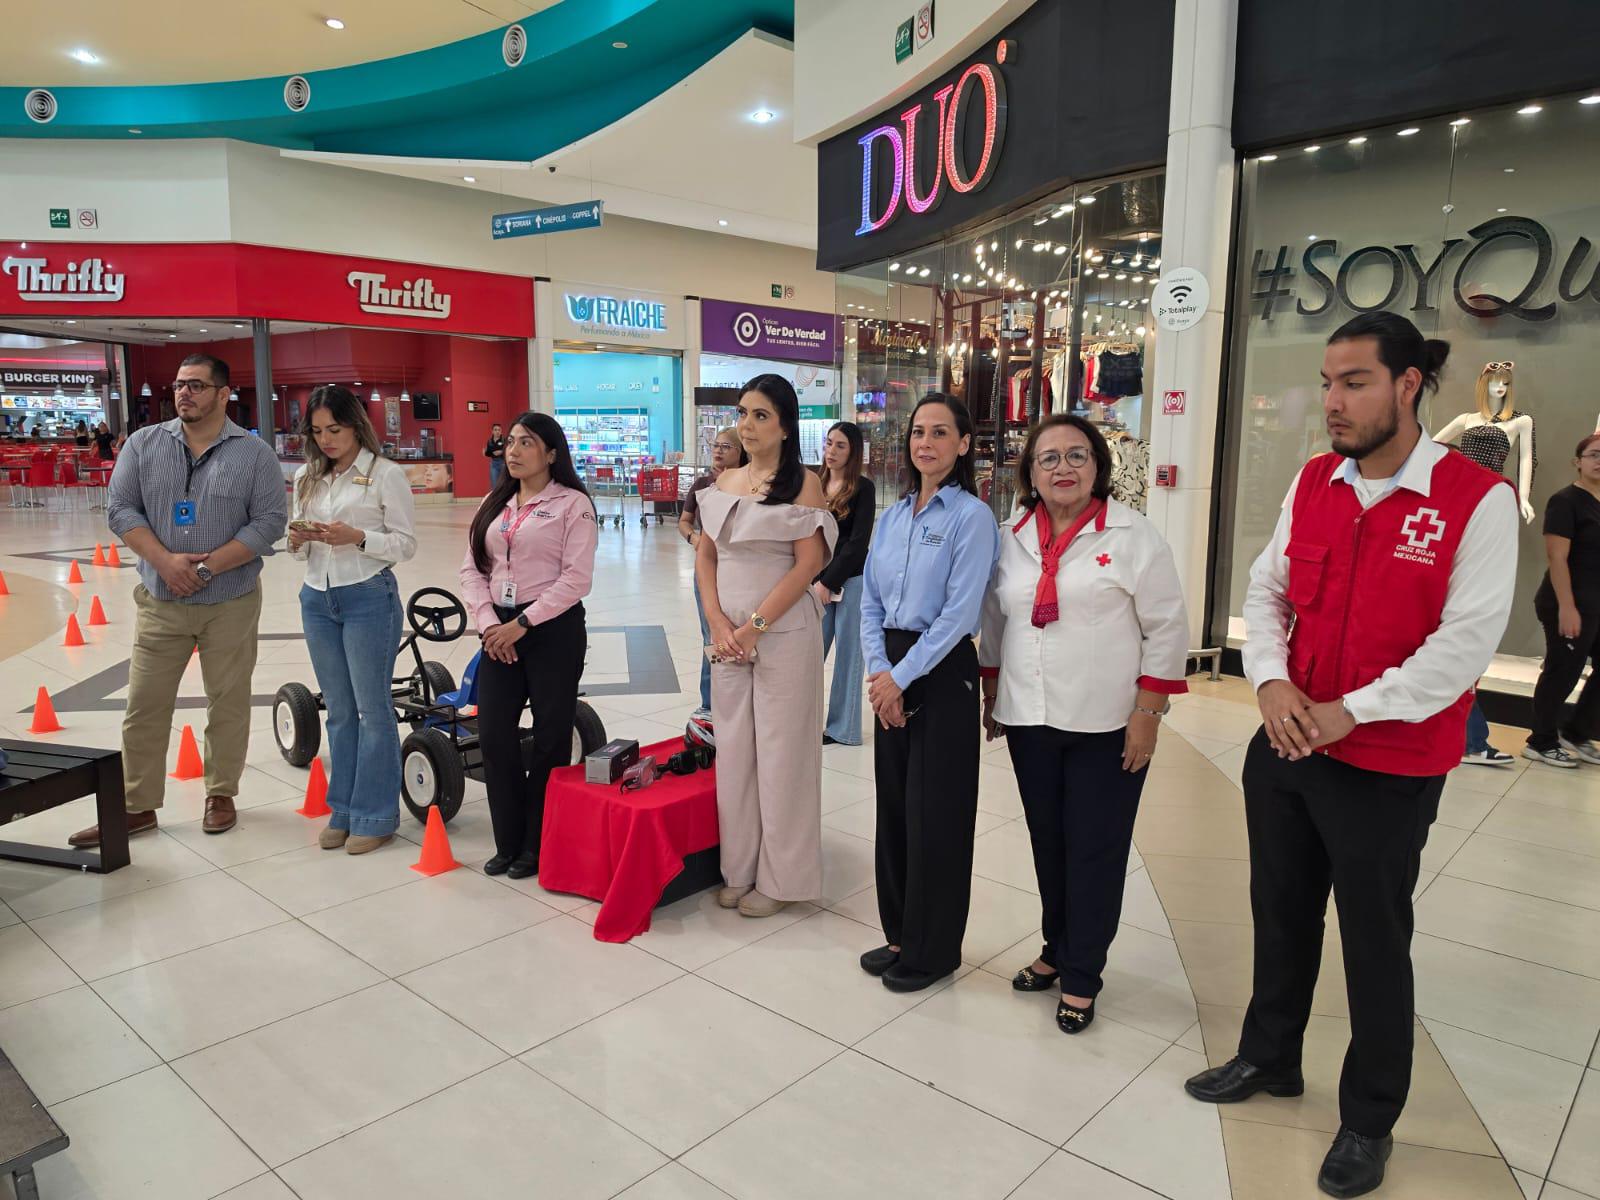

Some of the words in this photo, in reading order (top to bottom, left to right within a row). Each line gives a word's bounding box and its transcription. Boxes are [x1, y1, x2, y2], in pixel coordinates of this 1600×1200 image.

[855, 62, 1004, 237] DUO
[571, 209, 592, 220] COPPEL
[2, 256, 125, 302] Thrifty
[347, 271, 451, 319] Thrifty
[595, 297, 668, 330] FRAICHE
[1167, 305, 1197, 315] Totalplay
[580, 325, 620, 337] Perfumando
[765, 325, 782, 336] Ver
[782, 326, 794, 337] De
[794, 328, 826, 341] Verdad
[4, 372, 60, 383] BURGER
[61, 374, 95, 384] KING
[1393, 551, 1435, 566] MEXICANA
[1395, 544, 1414, 553] CRUZ
[1415, 547, 1437, 559] ROJA
